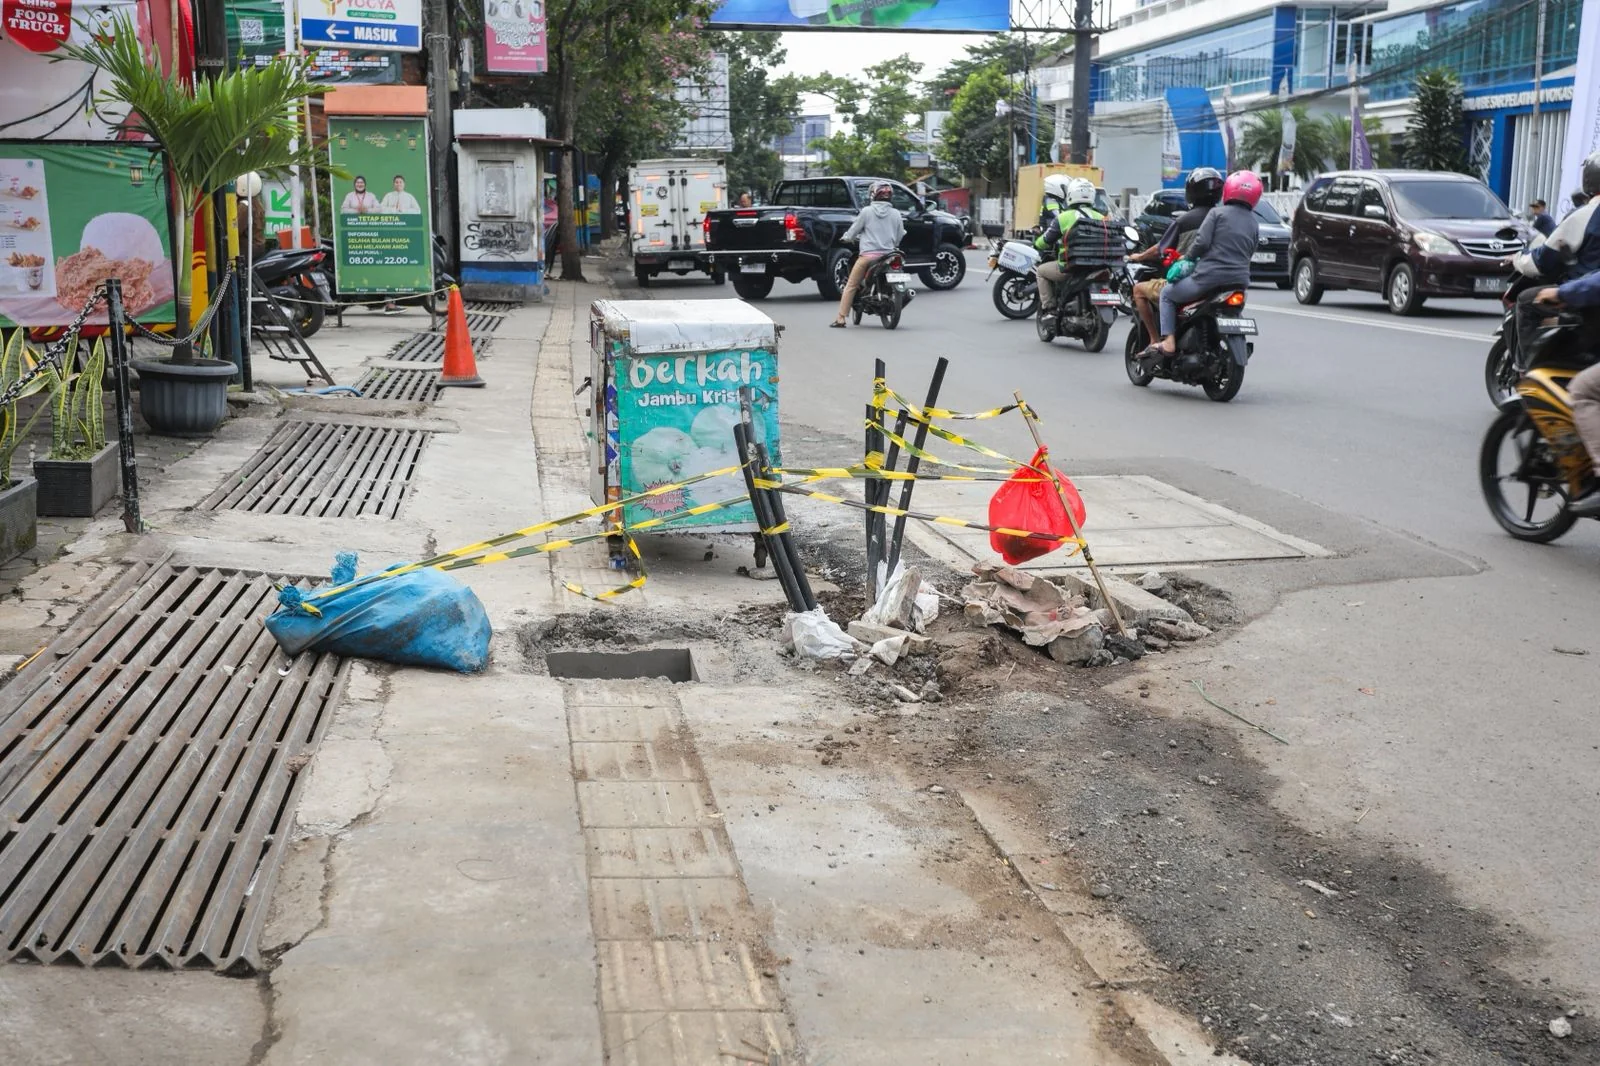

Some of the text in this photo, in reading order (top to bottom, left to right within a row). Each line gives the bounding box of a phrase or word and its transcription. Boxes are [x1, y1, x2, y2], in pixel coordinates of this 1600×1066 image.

[15, 8, 59, 23] FOOD
[8, 17, 66, 35] TRUCK
[353, 26, 398, 42] MASUK
[1545, 86, 1574, 102] VOKAS
[349, 256, 374, 264] 08.00
[384, 256, 408, 264] 22.00
[629, 351, 763, 389] Berkah
[638, 387, 756, 407] Jambu Kristl
